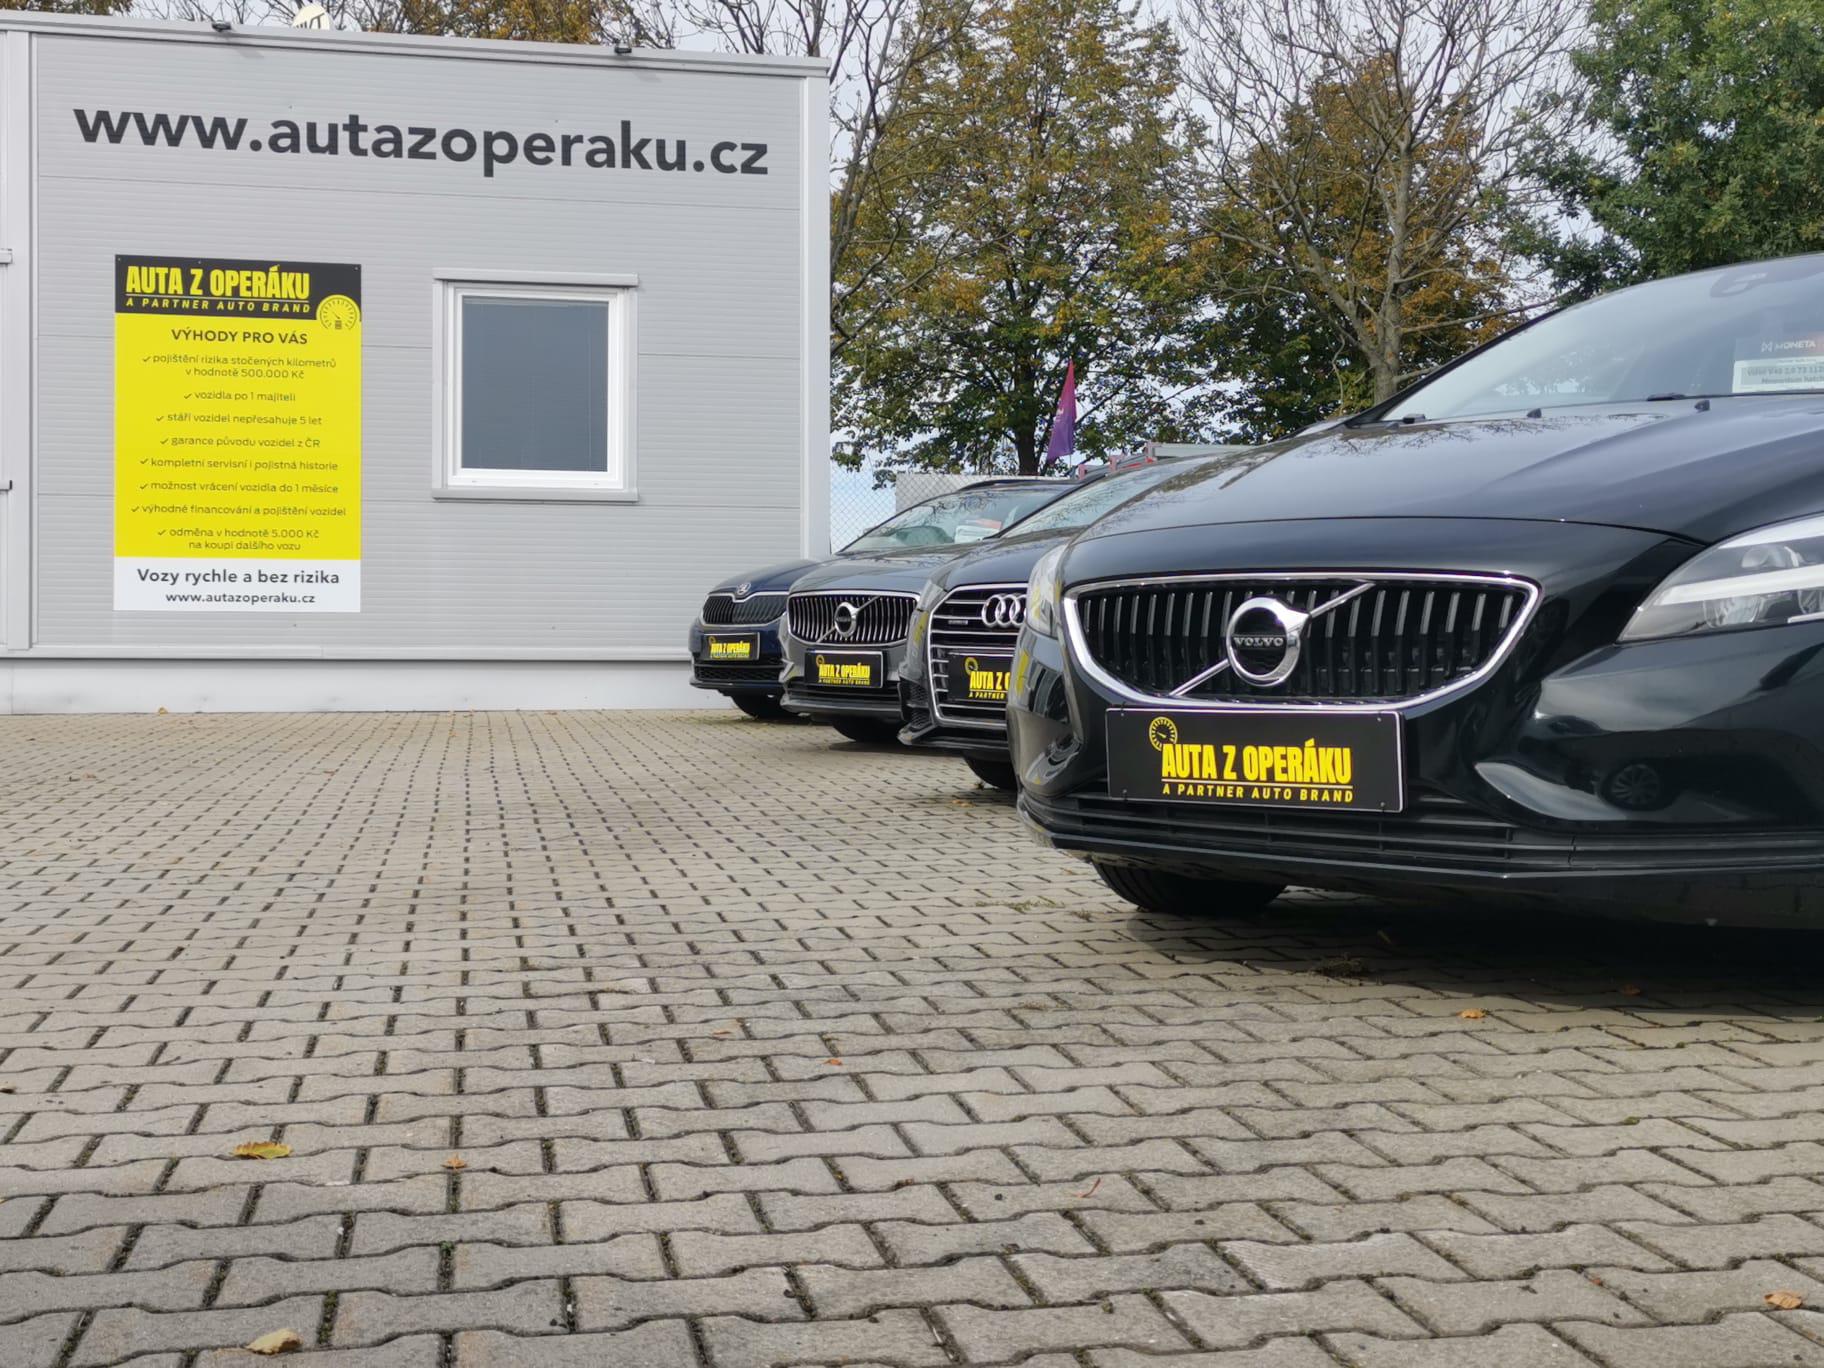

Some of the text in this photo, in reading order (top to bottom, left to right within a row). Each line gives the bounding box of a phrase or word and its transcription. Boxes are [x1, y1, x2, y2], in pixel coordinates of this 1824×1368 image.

[73, 108, 769, 177] www.autazoperaku.cz
[126, 265, 310, 299] AUTA Z OPERÁKU
[142, 300, 209, 309] PARTNER
[217, 302, 254, 311] AUTO
[262, 303, 310, 313] BRAND
[172, 327, 307, 344] VÝHODY PRO VÁS
[153, 354, 336, 368] pojištění rizika stočených kilometrů
[193, 367, 238, 377] hodnotě
[241, 369, 289, 378] 500.000
[291, 370, 304, 379] Kč
[194, 391, 295, 402] vozidla po 1 majiteli
[167, 412, 322, 426] stáří vozidel nepřesahuje 5 let
[171, 437, 213, 447] garance
[216, 436, 256, 448] původu
[258, 438, 295, 447] vozidel
[305, 437, 320, 448] ČR
[151, 458, 204, 469] kompletní
[207, 459, 247, 469] servisní
[254, 461, 296, 471] pojistná
[300, 461, 338, 470] historie
[151, 481, 338, 493] možnost vrácení vozidla do 1 měsíce
[142, 505, 188, 514] výhodné
[191, 505, 251, 514] financování
[263, 505, 307, 517] pojištění
[310, 507, 346, 516] vozidel
[170, 528, 214, 537] odměna
[224, 528, 269, 537] hodnotě
[272, 530, 303, 538] 5.000
[306, 529, 319, 538] Kč
[205, 541, 233, 550] koupi
[236, 540, 274, 549] dalšího
[137, 569, 339, 586] Vozy rychle a bez rizika
[166, 593, 316, 605] www.autazoperaku.cz
[1234, 636, 1284, 647] VOLVO
[970, 671, 993, 689] AUTA
[996, 672, 1002, 689] Z
[1162, 738, 1351, 784] AUTA Z OPERÁKU
[1163, 784, 1353, 802] A PARTNER AUTO BRAND
